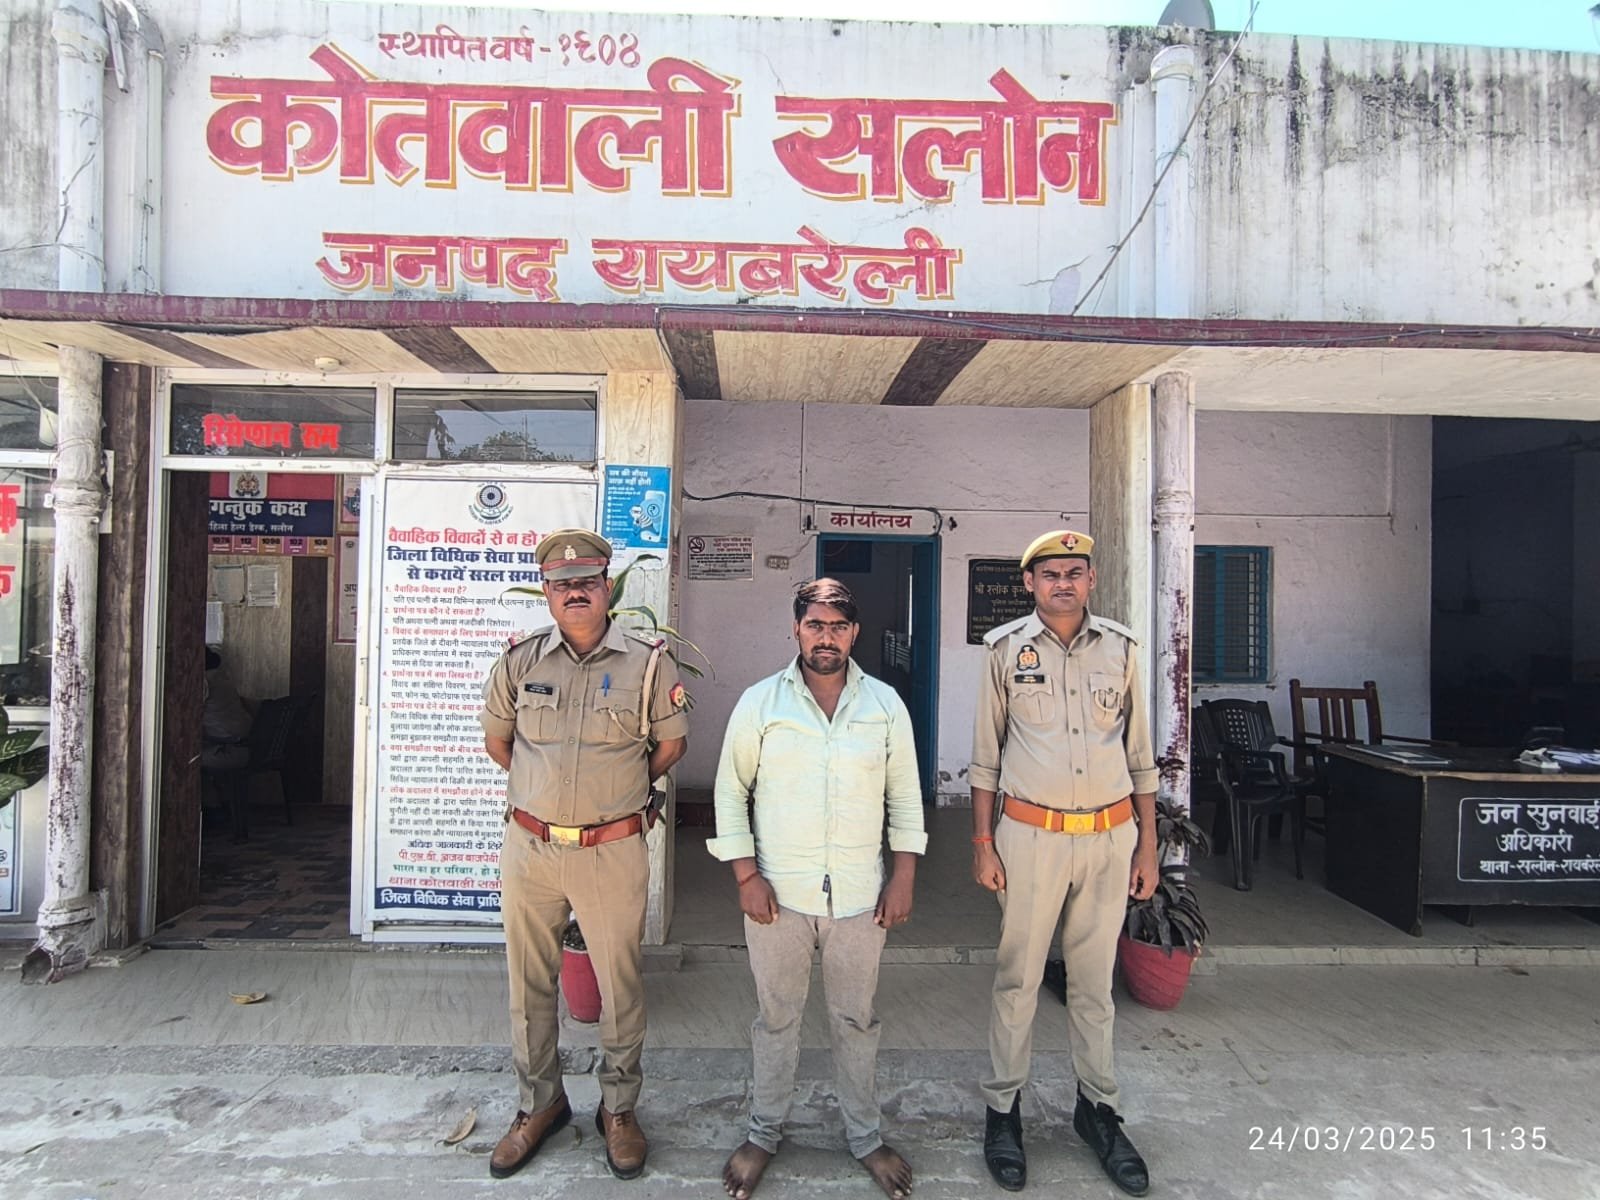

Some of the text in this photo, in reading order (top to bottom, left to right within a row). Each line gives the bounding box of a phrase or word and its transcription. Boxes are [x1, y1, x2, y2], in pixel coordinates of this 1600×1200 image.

[206, 42, 1119, 206] कोतवाली सलोन
[315, 225, 963, 303] जनपद रायबरेली
[208, 500, 308, 521] गन्तुक कक्ष
[830, 511, 912, 529] कार्यालय
[388, 527, 440, 544] वैवाहिक
[444, 527, 486, 545] विवादों
[490, 530, 502, 546] से
[506, 533, 518, 545] न
[521, 529, 537, 547] हो
[387, 545, 537, 564] जिला विधिक सेवा प्रा
[407, 565, 420, 580] से
[425, 565, 467, 581] करायें
[469, 569, 504, 582] सरल
[1475, 800, 1600, 831] जन सुनवाई
[1496, 828, 1574, 853] अधिकारी
[419, 876, 474, 889] कोतवाली
[381, 889, 411, 904] जिला
[414, 890, 449, 906] विधिक
[452, 892, 474, 906] सेवा
